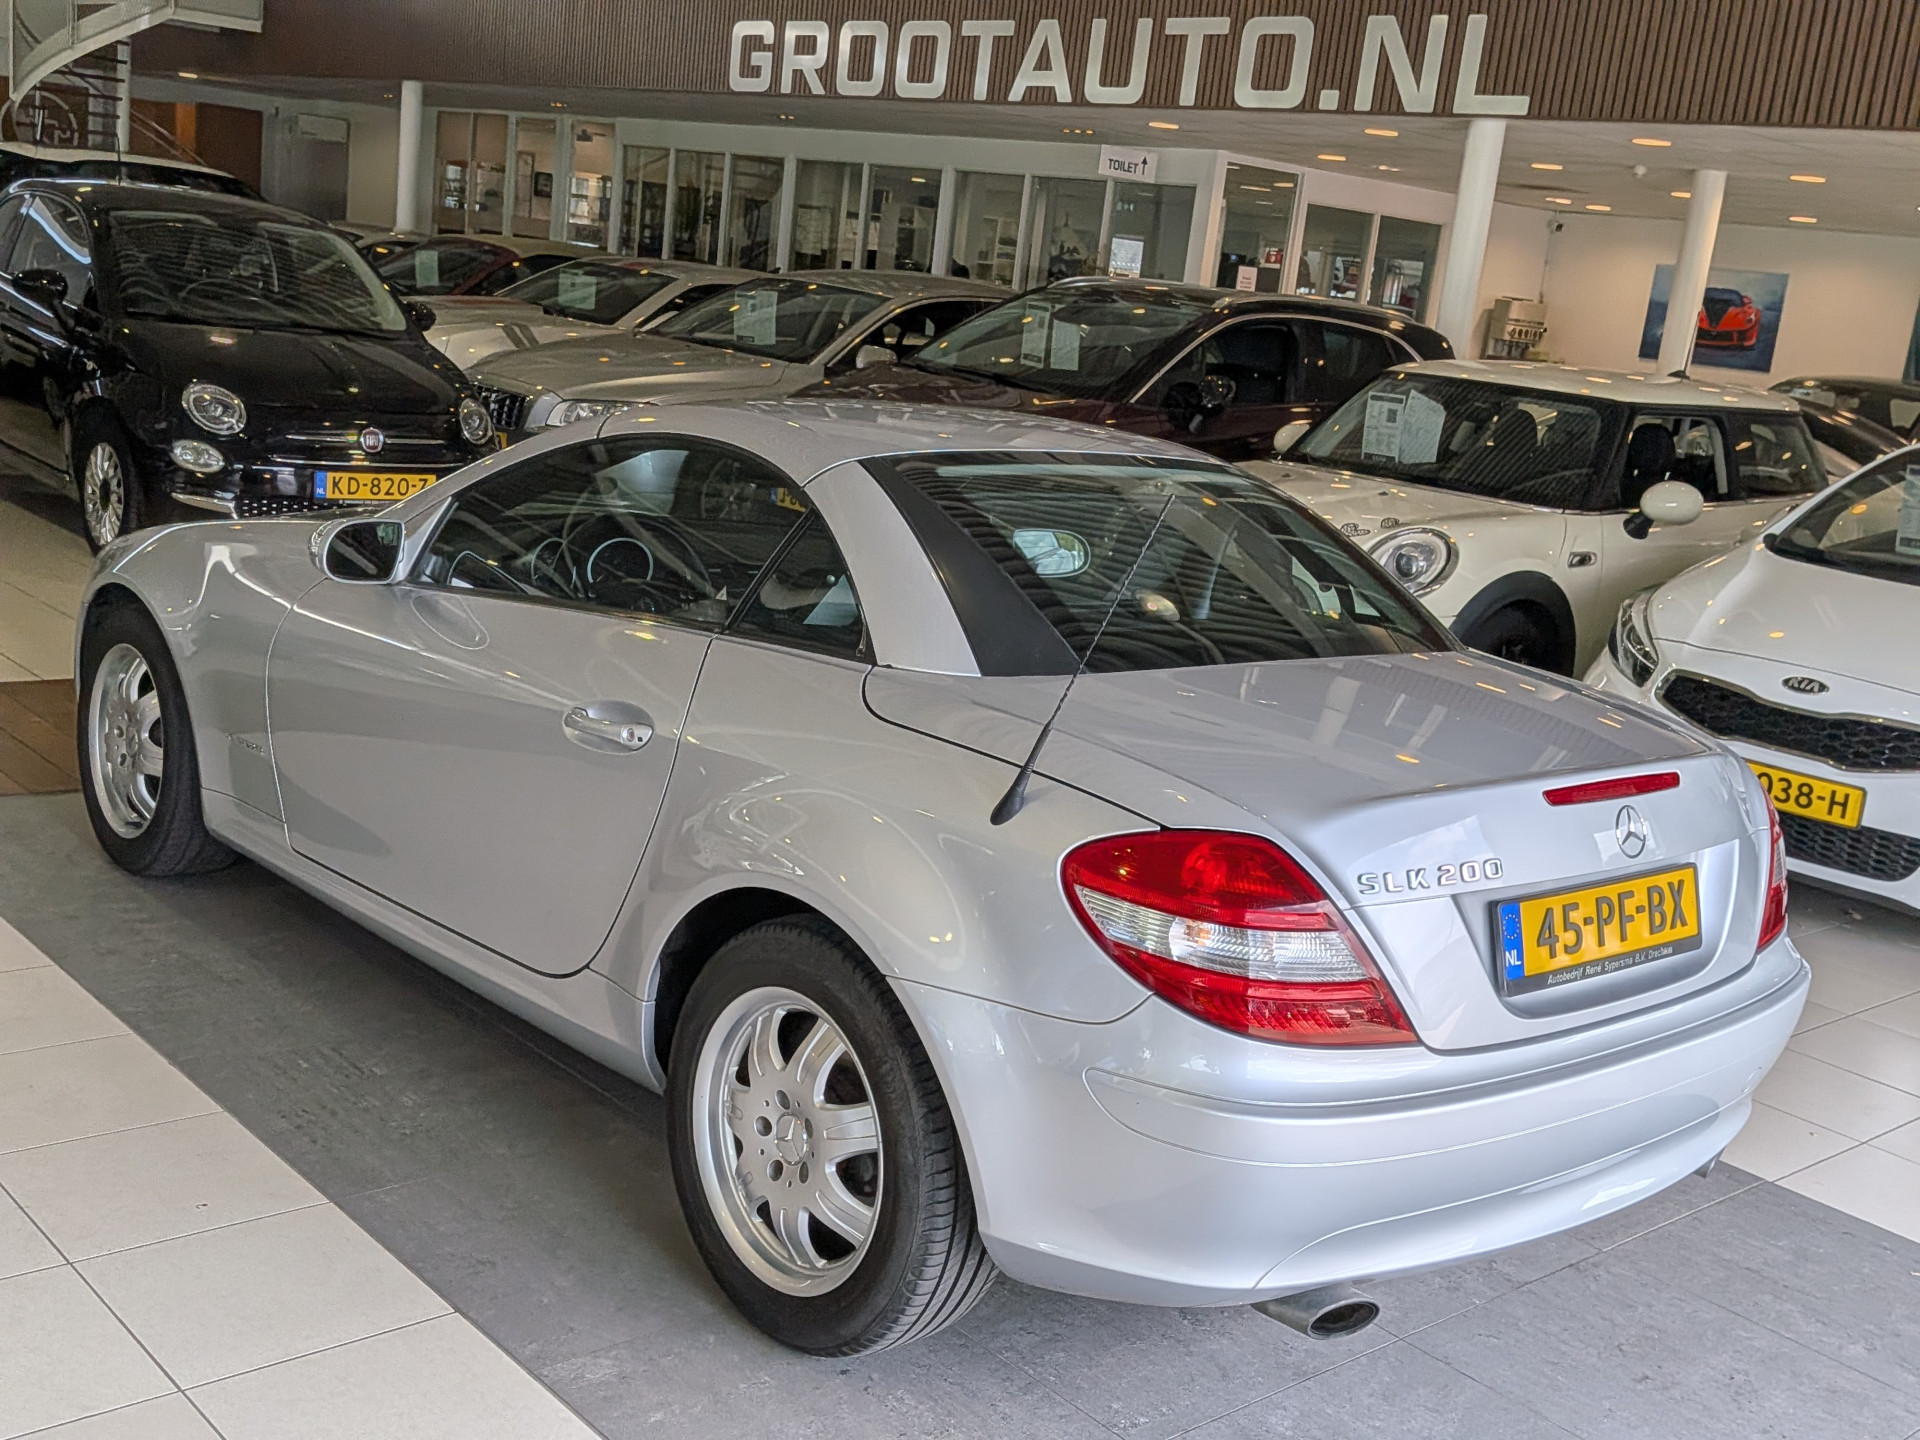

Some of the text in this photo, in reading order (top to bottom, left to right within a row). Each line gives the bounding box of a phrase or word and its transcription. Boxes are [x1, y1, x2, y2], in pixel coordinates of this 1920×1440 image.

[728, 14, 1530, 117] GROOTAUTO.NL
[1107, 158, 1139, 174] TOILET
[316, 487, 326, 495] NL
[1787, 678, 1820, 692] KIA
[1357, 858, 1503, 894] SLK 200
[1536, 879, 1689, 959] 45-PF-BX
[1505, 948, 1522, 967] NL
[1547, 966, 1584, 985] Autobedrijf
[1584, 961, 1602, 976] René
[1604, 955, 1633, 972] Sypersma
